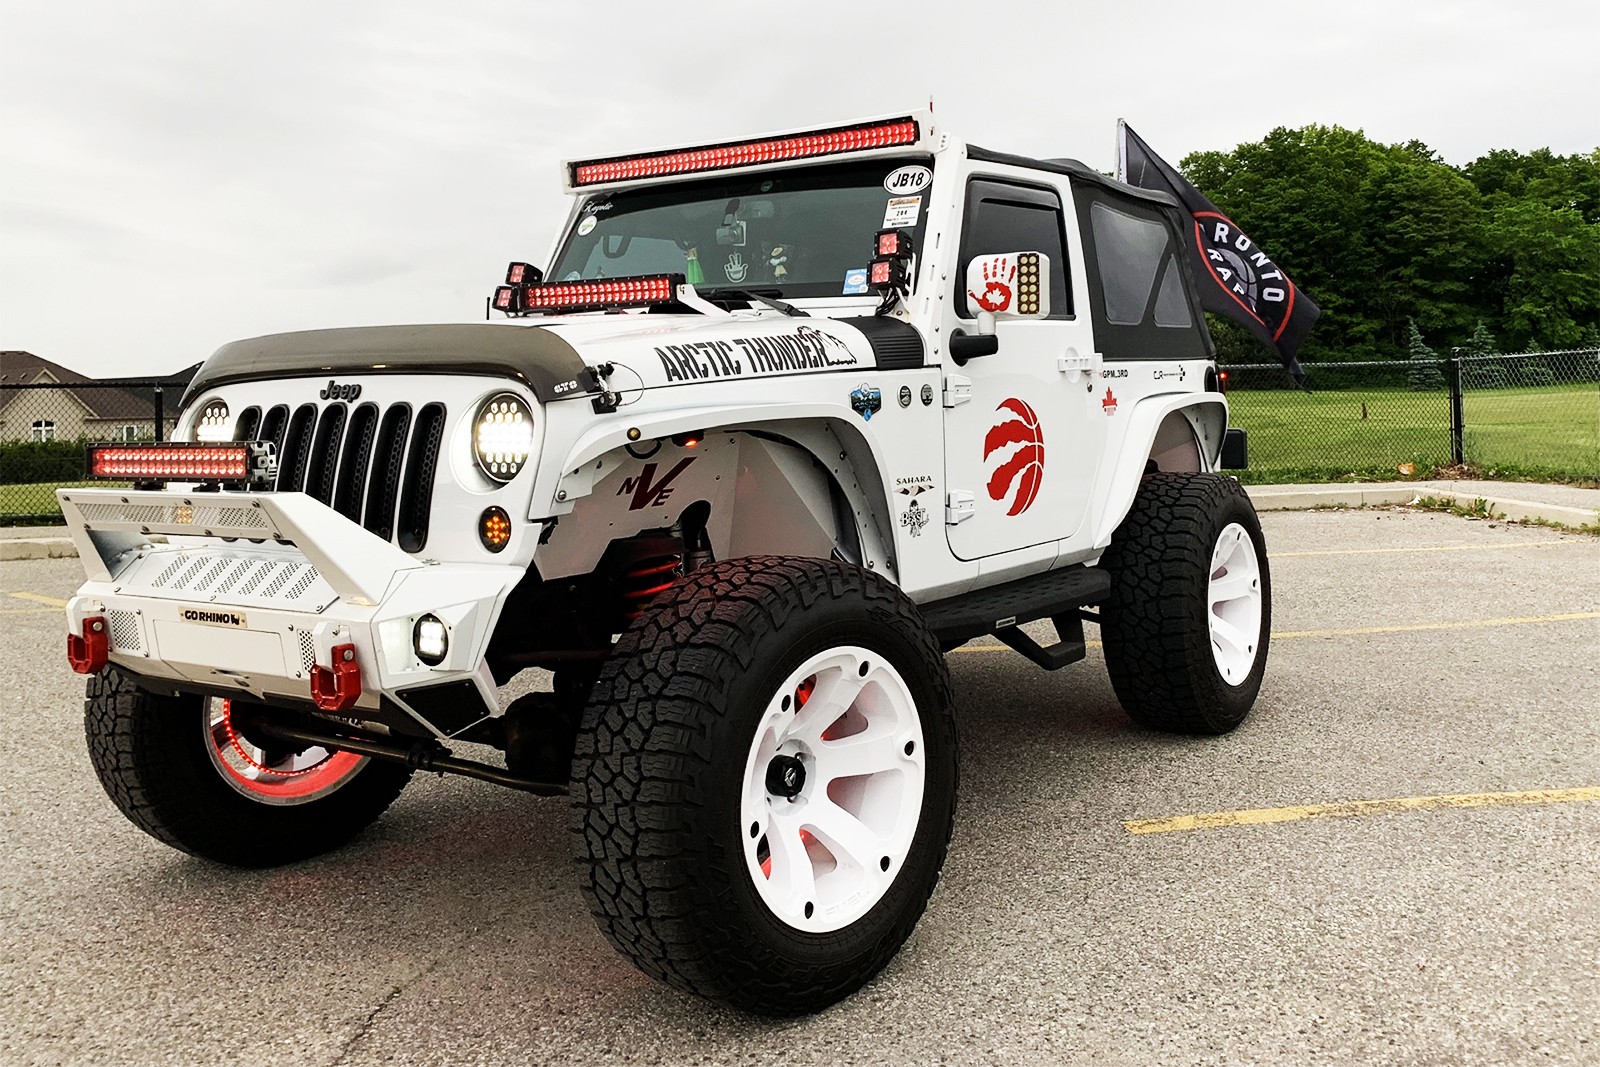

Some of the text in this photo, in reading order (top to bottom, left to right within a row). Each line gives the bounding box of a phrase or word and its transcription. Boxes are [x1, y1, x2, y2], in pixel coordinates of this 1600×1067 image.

[892, 172, 924, 187] JB18
[653, 333, 830, 382] ARCTIC THUNDER
[319, 380, 362, 403] Jeep
[896, 475, 932, 486] SAHARA
